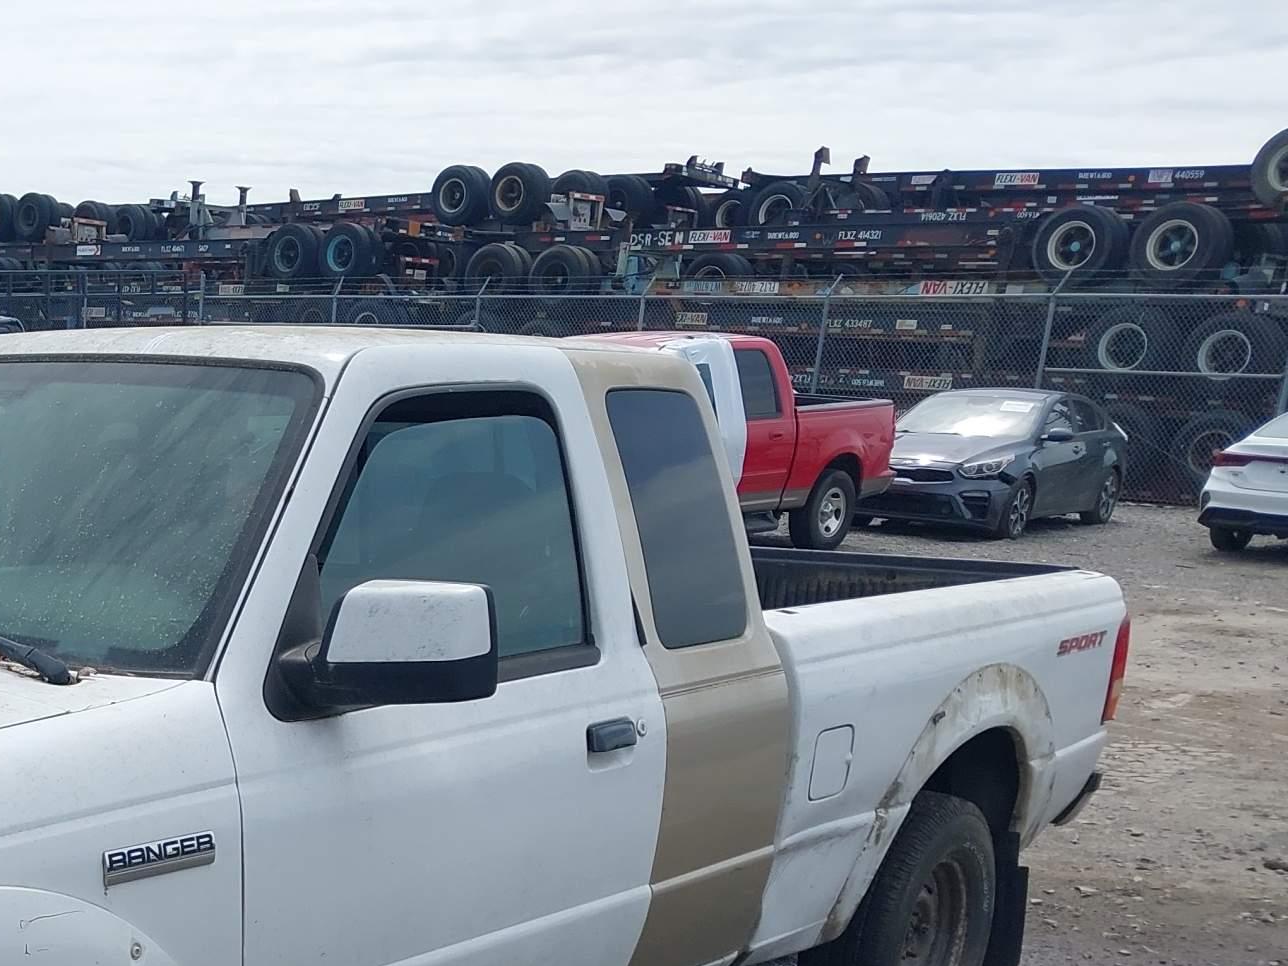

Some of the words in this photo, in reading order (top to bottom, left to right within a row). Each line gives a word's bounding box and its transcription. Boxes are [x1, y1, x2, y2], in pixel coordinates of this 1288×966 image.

[995, 173, 1038, 184] FLEXI-VAN
[1175, 170, 1205, 180] 440559
[689, 231, 730, 241] FLEXI-VAN
[838, 231, 856, 240] FLXZ
[920, 281, 987, 294] FLEXI-VAN
[1056, 629, 1108, 657] SPORT
[106, 832, 215, 873] RANGER
